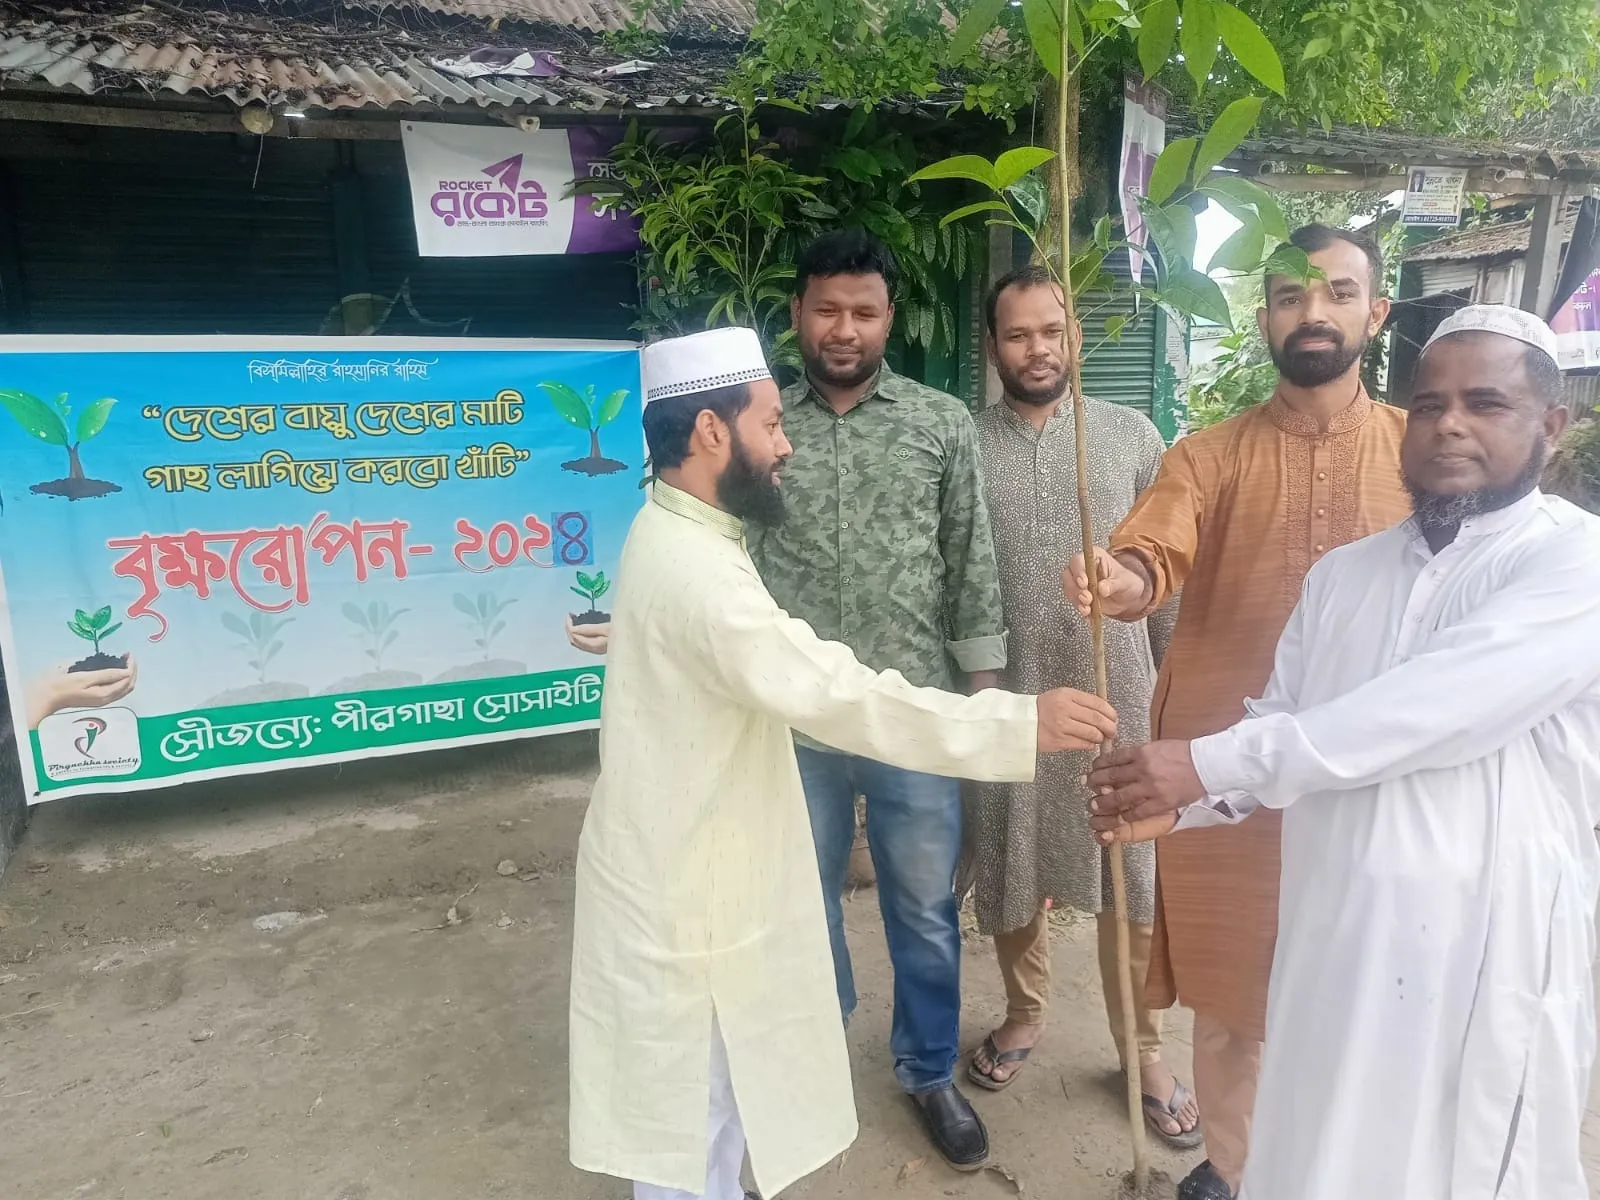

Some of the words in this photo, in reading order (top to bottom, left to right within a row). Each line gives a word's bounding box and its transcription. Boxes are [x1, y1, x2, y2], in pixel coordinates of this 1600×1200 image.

[430, 180, 548, 227] রকেট
[439, 181, 492, 191] ROCKET
[142, 405, 277, 442] “দেশের
[281, 402, 357, 439] বায়ু
[355, 401, 456, 436] দেশের
[461, 389, 525, 425] মাটি
[143, 464, 211, 492] গাছ
[214, 449, 339, 494] লাগিয়ে
[343, 455, 449, 489] করবো
[455, 441, 531, 480] খাঁটি”
[454, 511, 589, 573] ২০২৪
[331, 699, 465, 732] পীরগাছা
[473, 672, 602, 723] সোসাইটি
